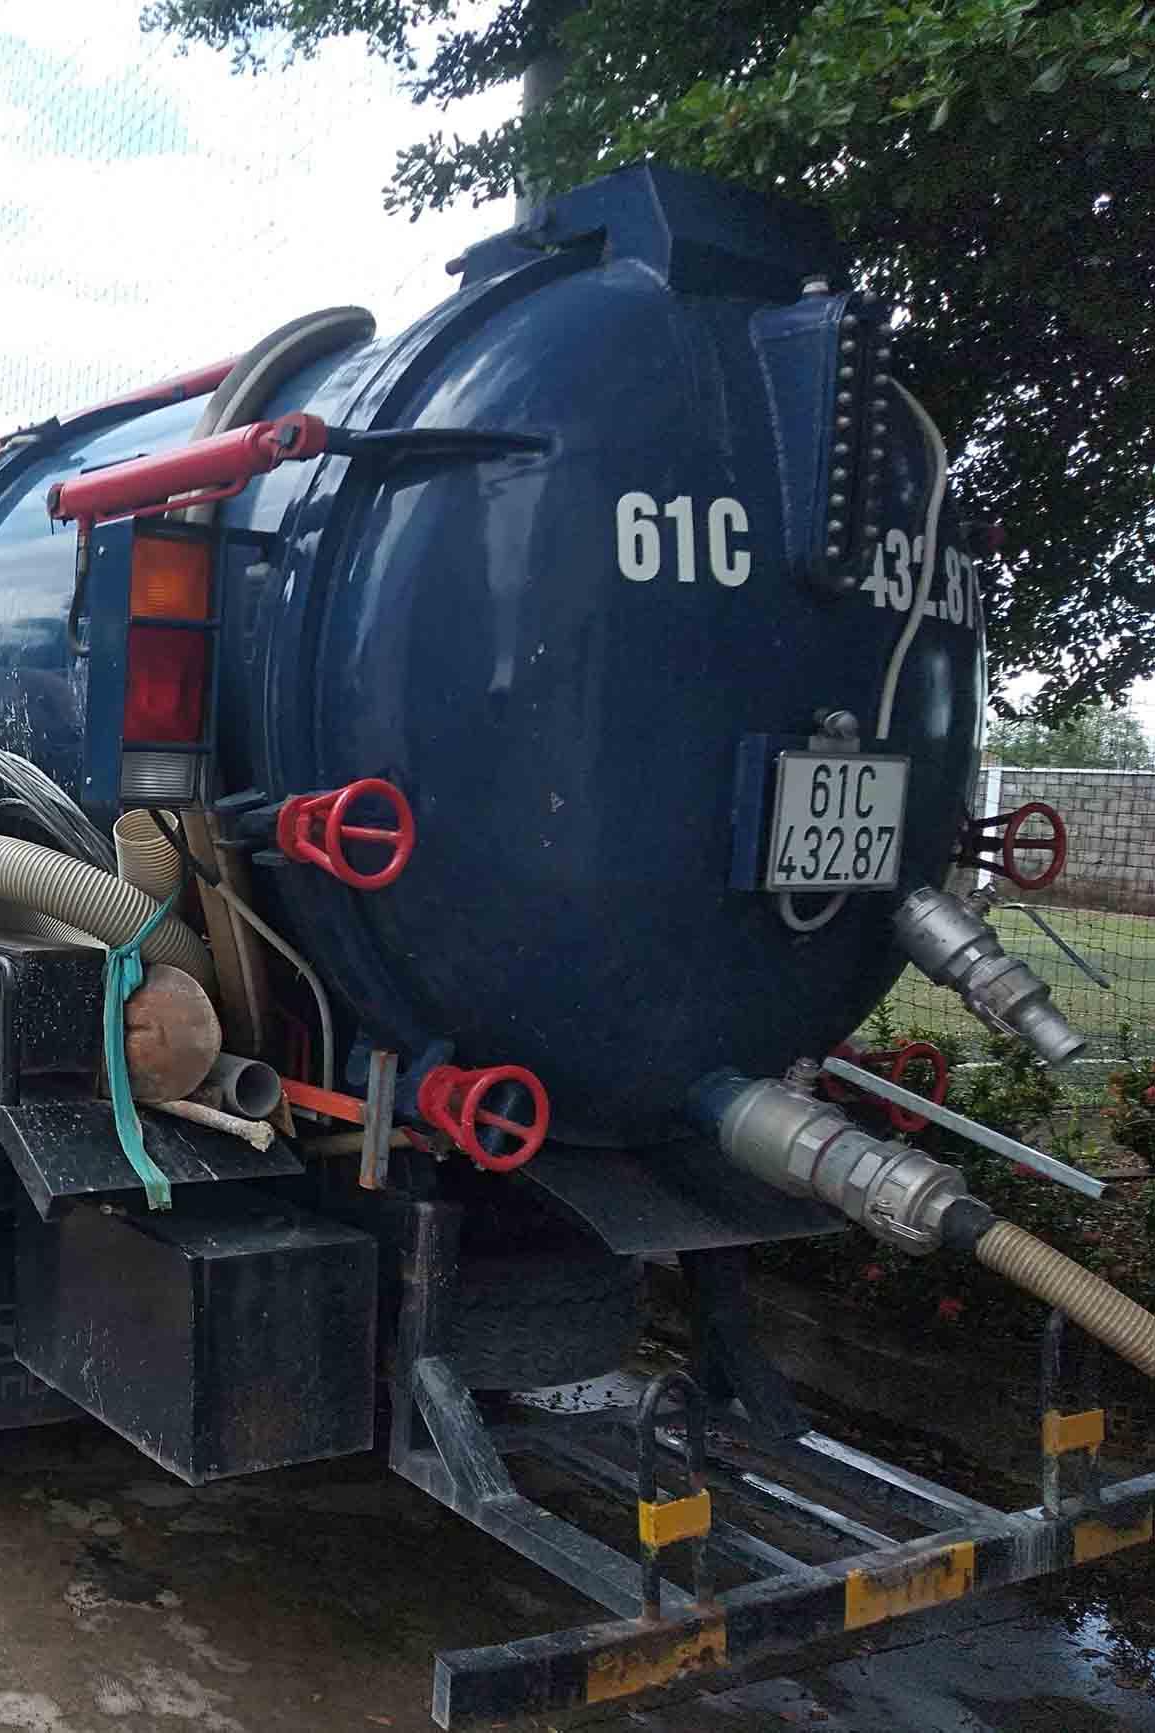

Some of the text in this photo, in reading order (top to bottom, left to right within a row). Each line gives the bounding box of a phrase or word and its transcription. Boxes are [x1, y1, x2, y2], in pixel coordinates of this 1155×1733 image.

[616, 491, 752, 588] 61C
[810, 764, 876, 819] 61C
[777, 825, 896, 881] 432.87
